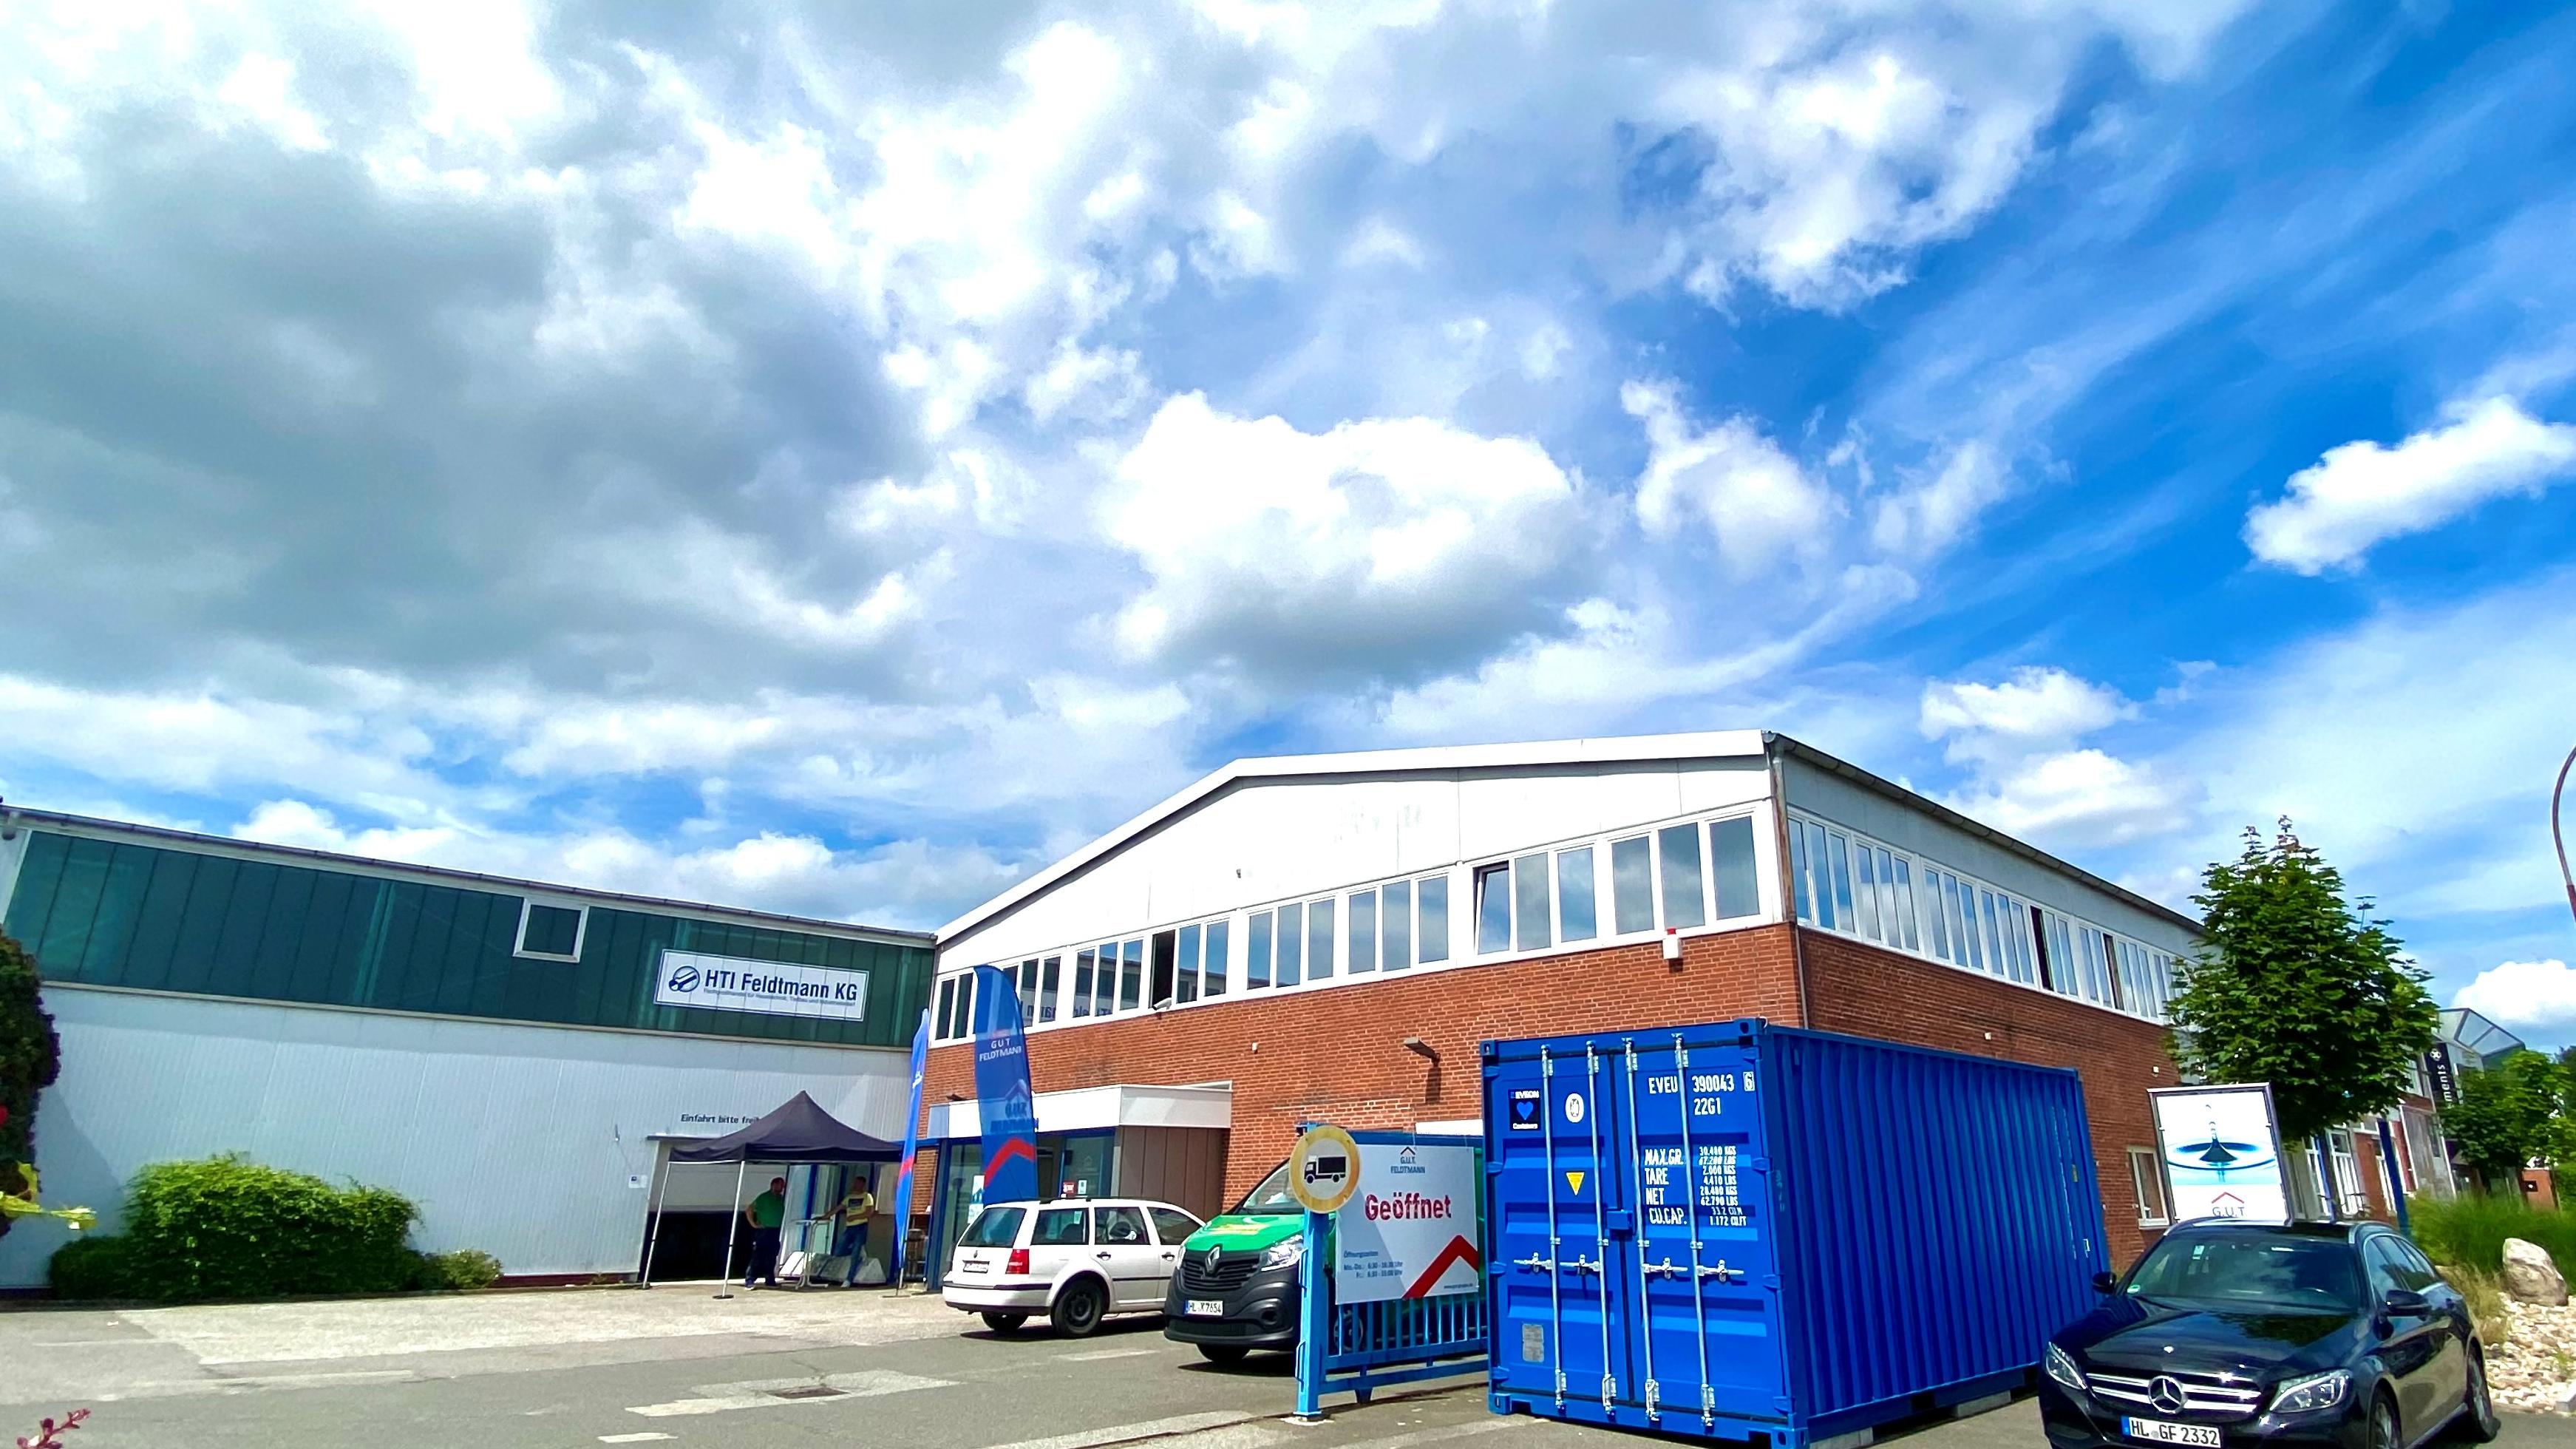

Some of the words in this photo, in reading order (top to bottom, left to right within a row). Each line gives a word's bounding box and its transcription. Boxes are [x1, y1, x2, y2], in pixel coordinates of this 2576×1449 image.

[704, 968, 735, 989] HTI
[741, 973, 829, 998] Feldtmann
[835, 983, 858, 1001] KG
[1648, 1076, 1679, 1094] EVEU
[1691, 1073, 1735, 1093] 390043
[1743, 1072, 1755, 1091] 6
[1693, 1097, 1722, 1116] 22G1
[681, 1113, 716, 1123] Einfahrt
[718, 1115, 739, 1124] bitte
[1645, 1148, 1684, 1166] MAX.GR.
[1390, 1165, 1426, 1174] FELDTMANN
[1645, 1167, 1670, 1184] TARE
[1702, 1165, 1722, 1175] 2.000
[1703, 1175, 1723, 1185] 4.410
[1645, 1187, 1665, 1205] NET
[1700, 1196, 1725, 1206] 62.790
[1725, 1195, 1739, 1206] LBS
[1365, 1192, 1452, 1221] Geöffnet
[1648, 1207, 1688, 1225] CU.CAP.
[1710, 1215, 1729, 1226] 1.172
[2131, 1420, 2150, 1437] HL
[2158, 1424, 2177, 1440] GF
[2181, 1427, 2219, 1446] 2332
